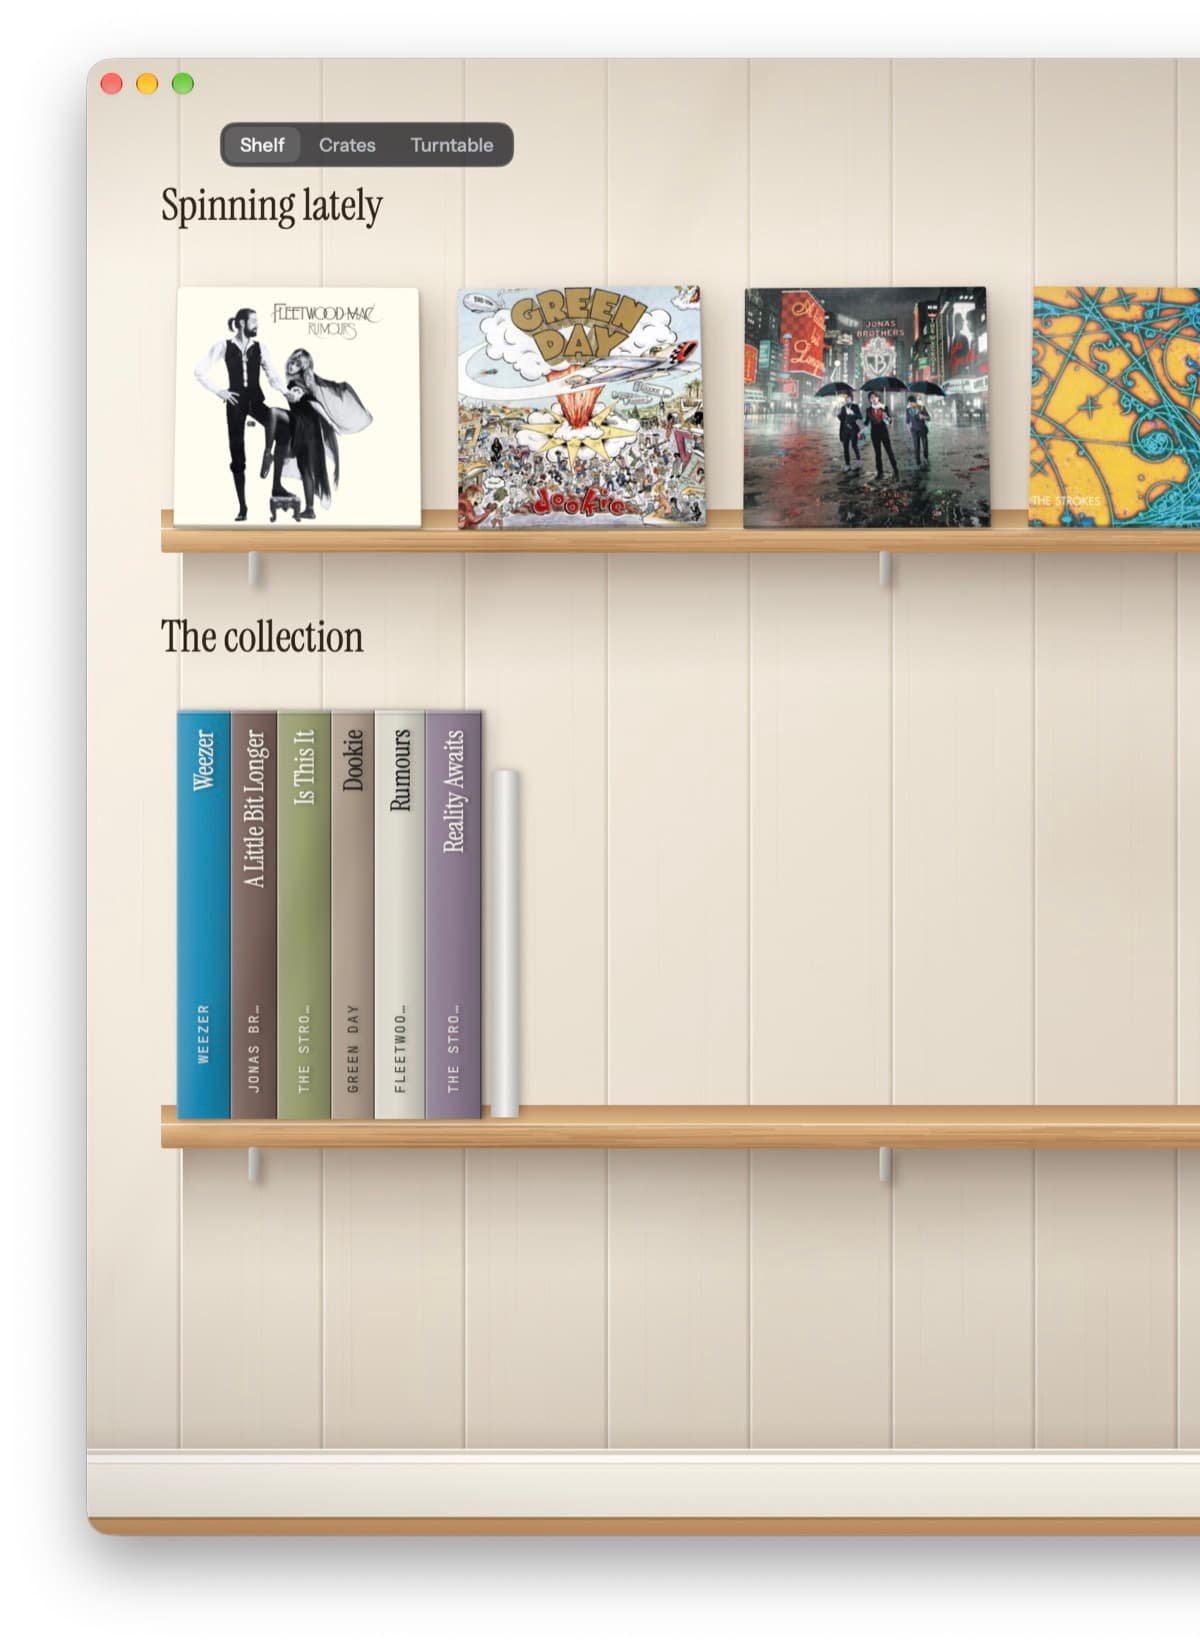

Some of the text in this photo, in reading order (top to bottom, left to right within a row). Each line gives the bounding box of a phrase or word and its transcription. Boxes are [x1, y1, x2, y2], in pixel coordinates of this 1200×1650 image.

[240, 136, 286, 153] Shelf
[319, 136, 376, 153] Crates
[410, 136, 495, 153] Turntable
[161, 186, 384, 230] Spinning lately
[272, 302, 380, 324] FLEETWOOD MAC
[510, 287, 649, 334] GREEN
[865, 320, 897, 328] JONAS
[308, 321, 358, 341] RUMOURS
[531, 323, 630, 363] DAY
[856, 329, 905, 337] BROTHERS
[533, 487, 626, 517] dookie
[1031, 495, 1102, 506] THE STROKES
[160, 618, 365, 653] The collection
[193, 728, 215, 792] Weezer
[293, 728, 315, 806] Is This It
[342, 728, 364, 793] Dookie
[389, 728, 411, 812] Rumours
[243, 728, 270, 889] A Little Bit Longer
[443, 729, 469, 854] Reality Awaits
[197, 1004, 209, 1065] WEEZER
[347, 1004, 359, 1094] GREEN DAY
[248, 1045, 260, 1094] JONAS
[298, 1064, 310, 1094] THE
[448, 1064, 460, 1094] THE
